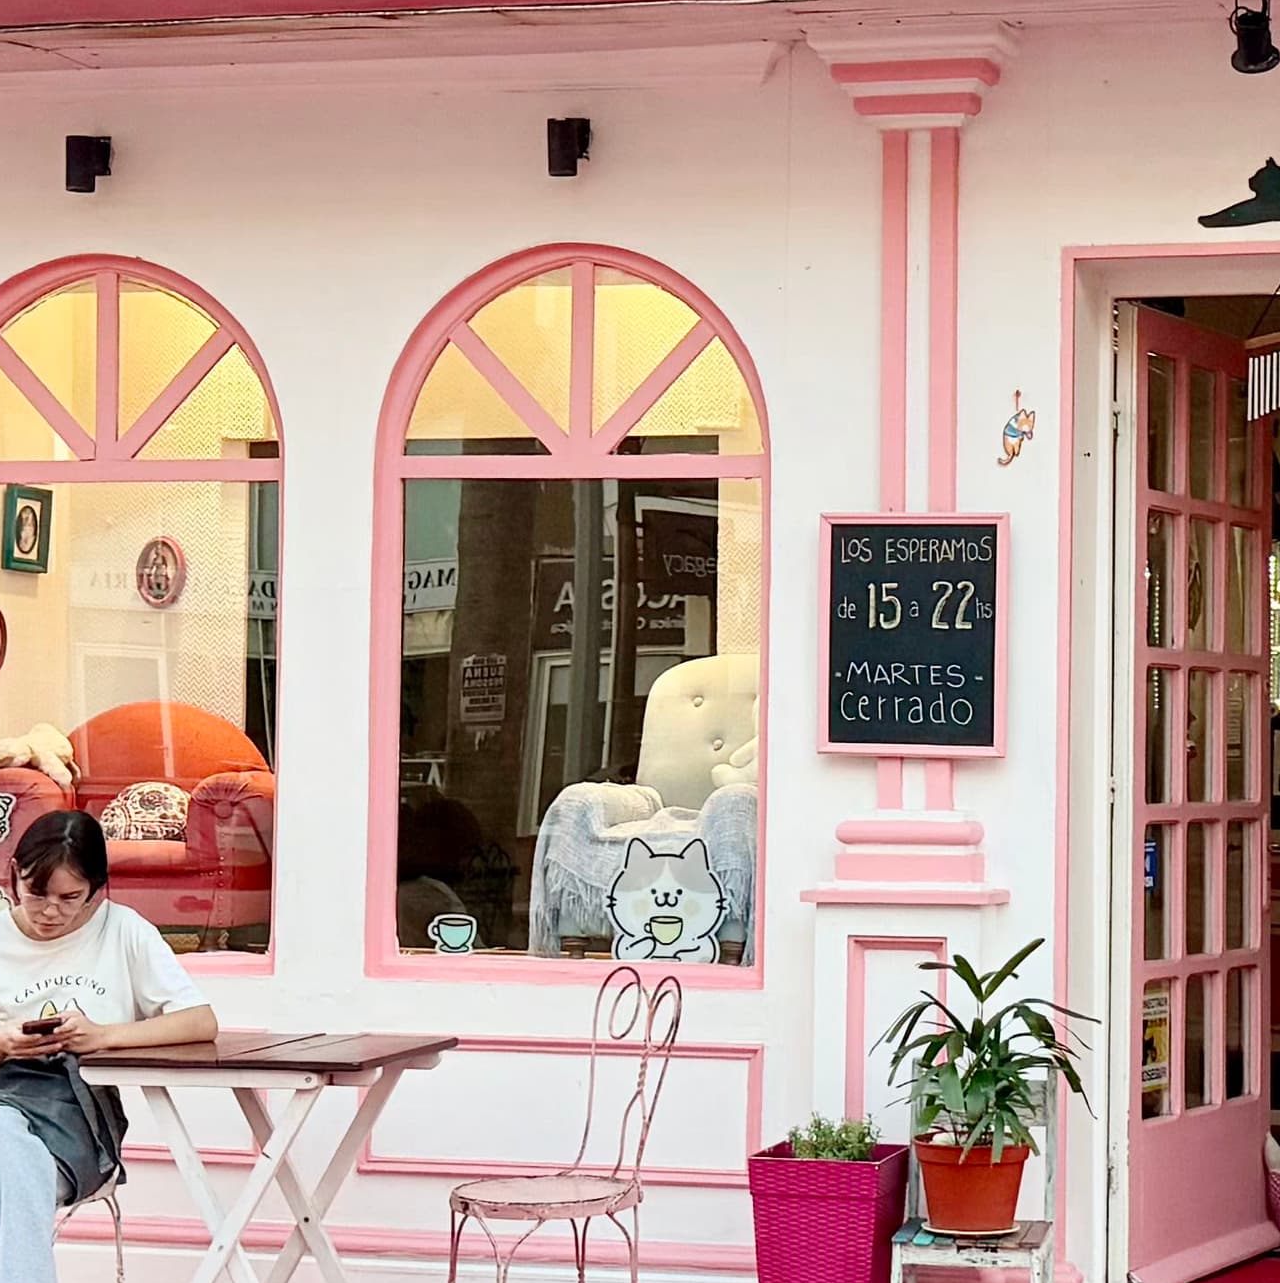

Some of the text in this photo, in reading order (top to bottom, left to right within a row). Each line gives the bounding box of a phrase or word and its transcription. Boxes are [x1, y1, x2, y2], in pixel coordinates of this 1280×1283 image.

[841, 537, 873, 563] LOS
[837, 595, 857, 619] de
[868, 582, 903, 629] 15
[909, 600, 919, 617] a
[932, 581, 976, 630] 22
[846, 661, 966, 688] MARTES
[840, 691, 974, 726] Cerrado
